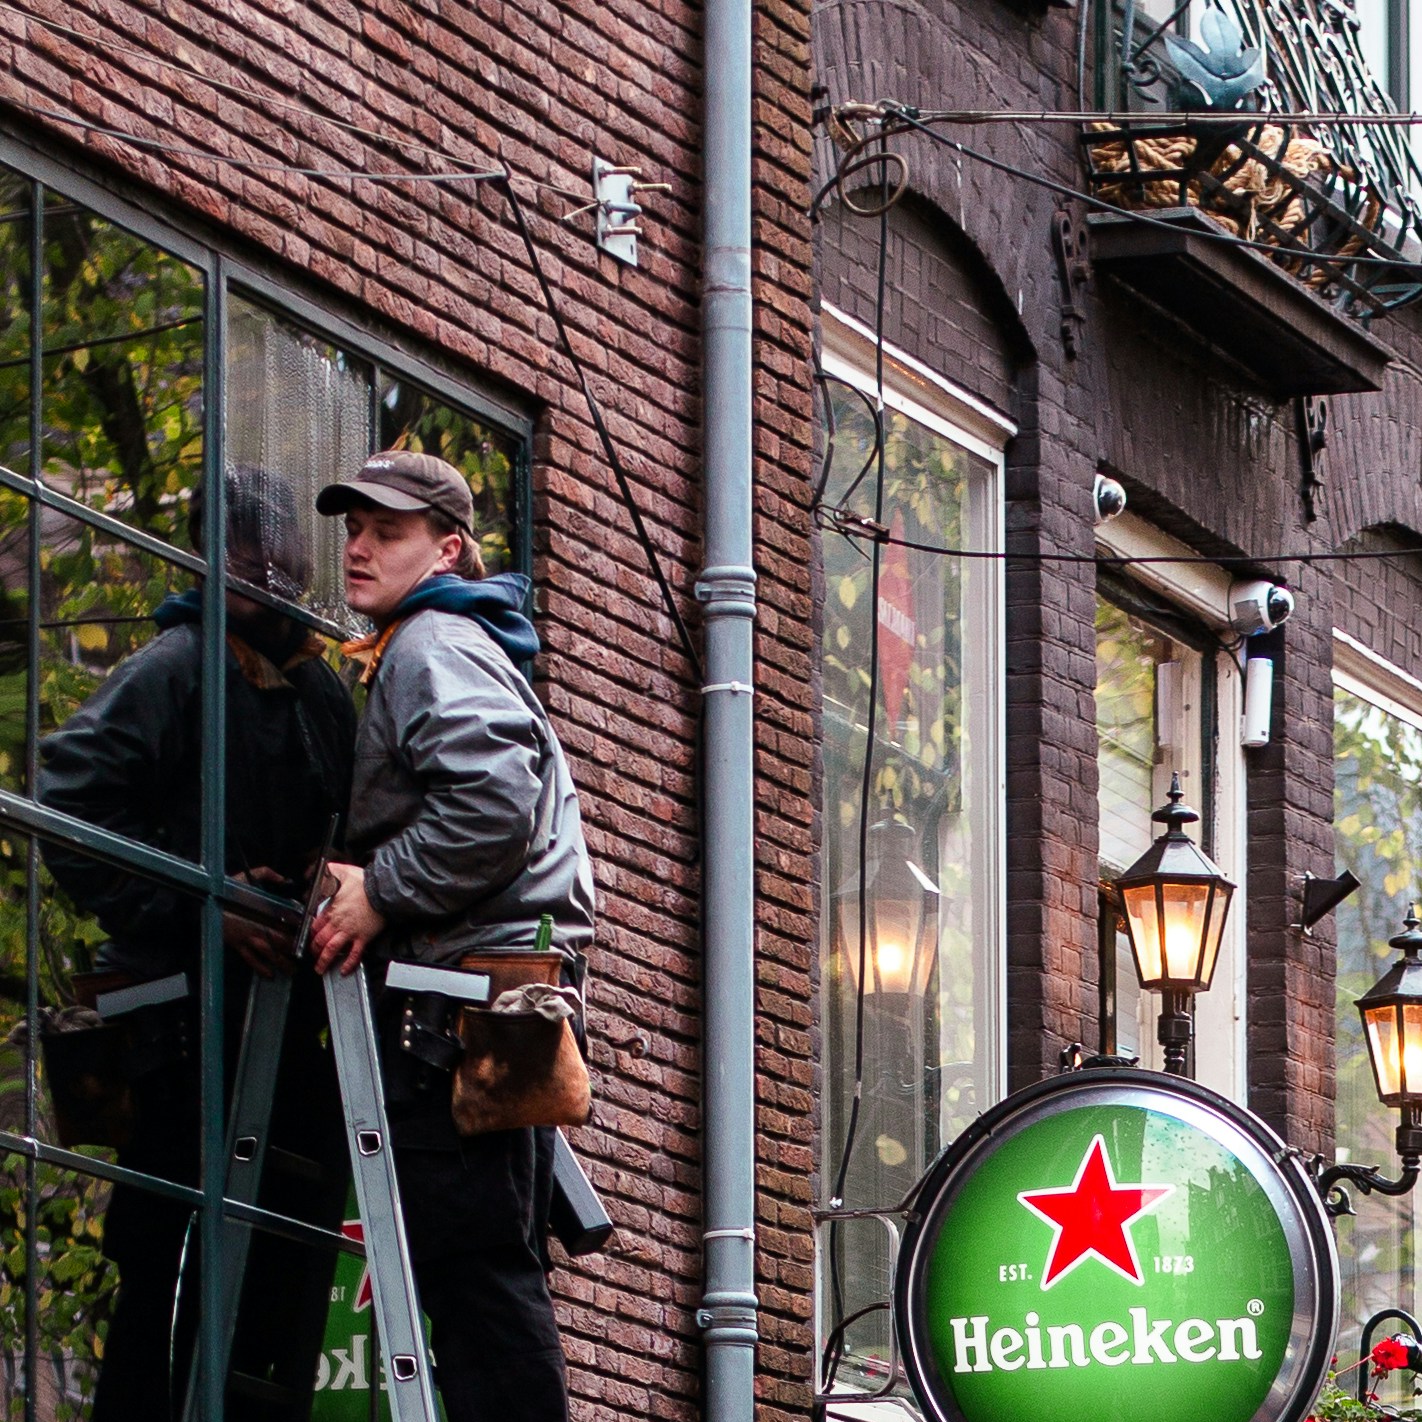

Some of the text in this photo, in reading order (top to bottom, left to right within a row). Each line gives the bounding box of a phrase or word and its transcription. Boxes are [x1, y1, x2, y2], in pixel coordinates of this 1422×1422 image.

[998, 1264, 1033, 1282] EST.
[1153, 1256, 1195, 1274] 1873
[950, 1306, 1263, 1373] Heineken
